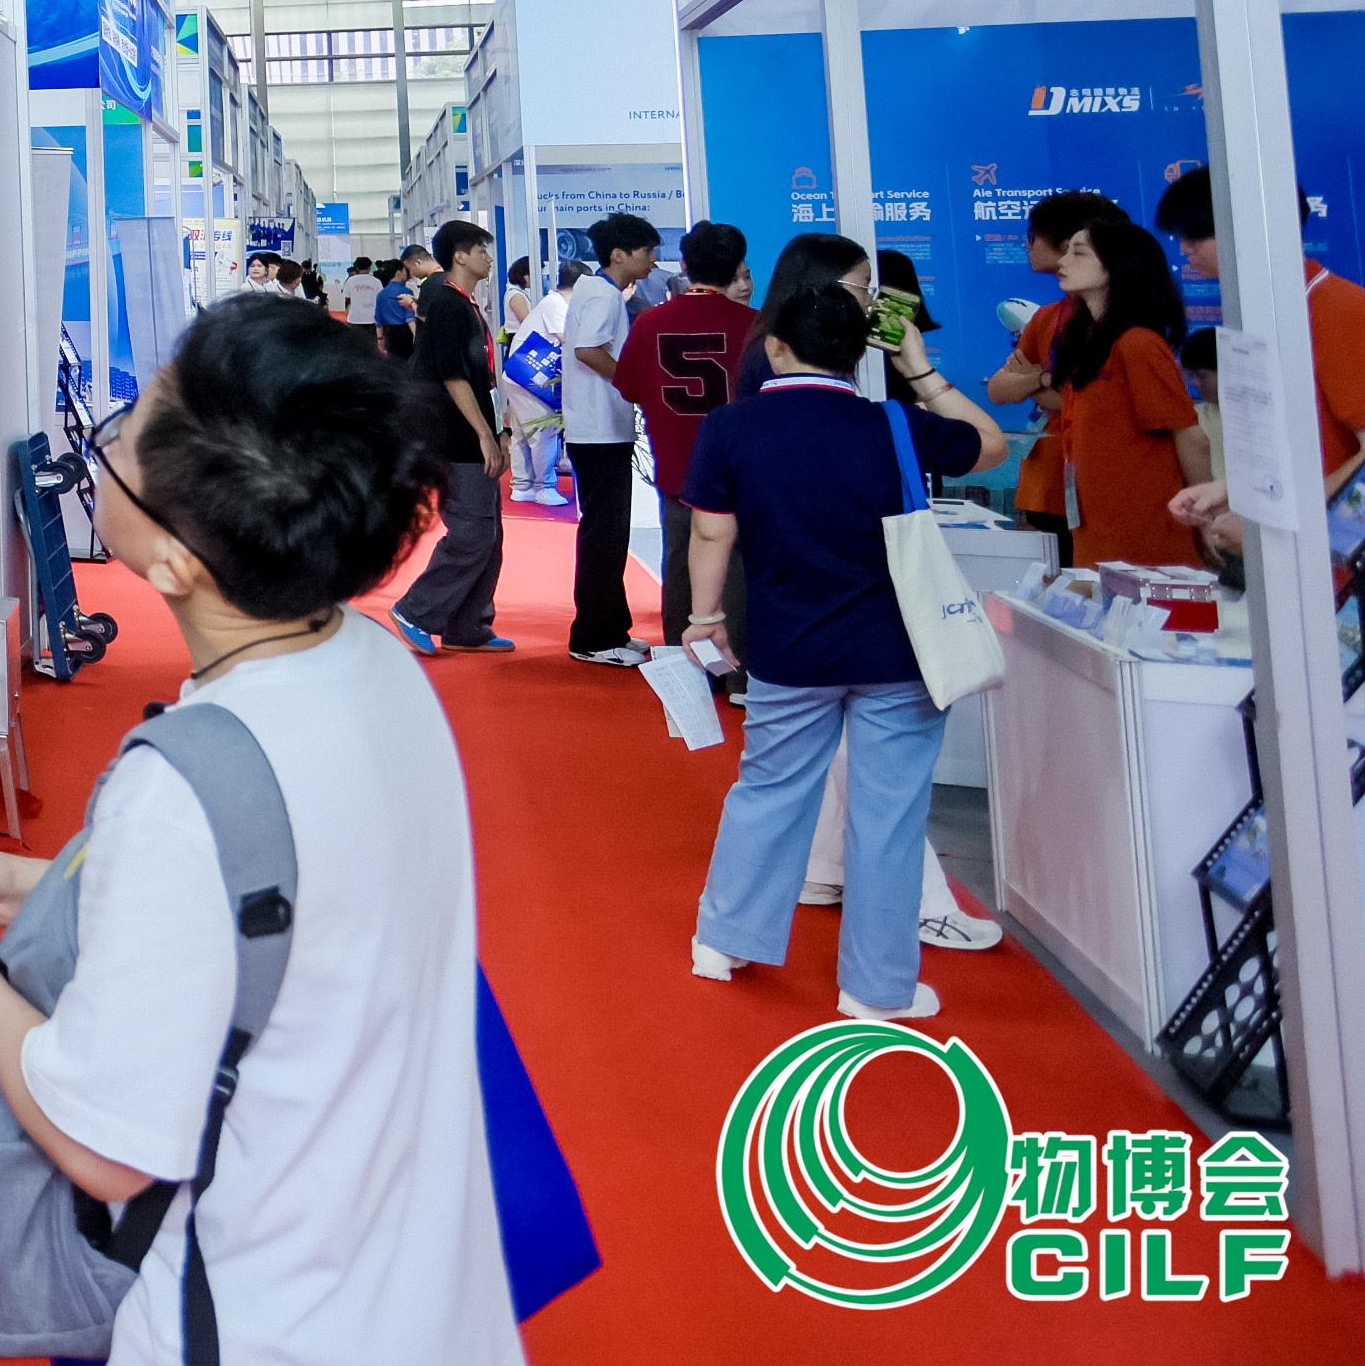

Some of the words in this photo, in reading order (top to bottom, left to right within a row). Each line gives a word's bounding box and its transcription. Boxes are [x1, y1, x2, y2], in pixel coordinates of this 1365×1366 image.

[561, 191, 585, 200] from
[588, 190, 617, 200] China
[619, 192, 631, 200] to
[634, 190, 663, 200] Russia
[791, 191, 827, 201] Ocean
[887, 190, 930, 200] Service
[994, 188, 1053, 200] Transport
[576, 204, 603, 214] ports
[605, 203, 615, 212] in
[617, 202, 650, 212] China:
[657, 332, 728, 417] 5
